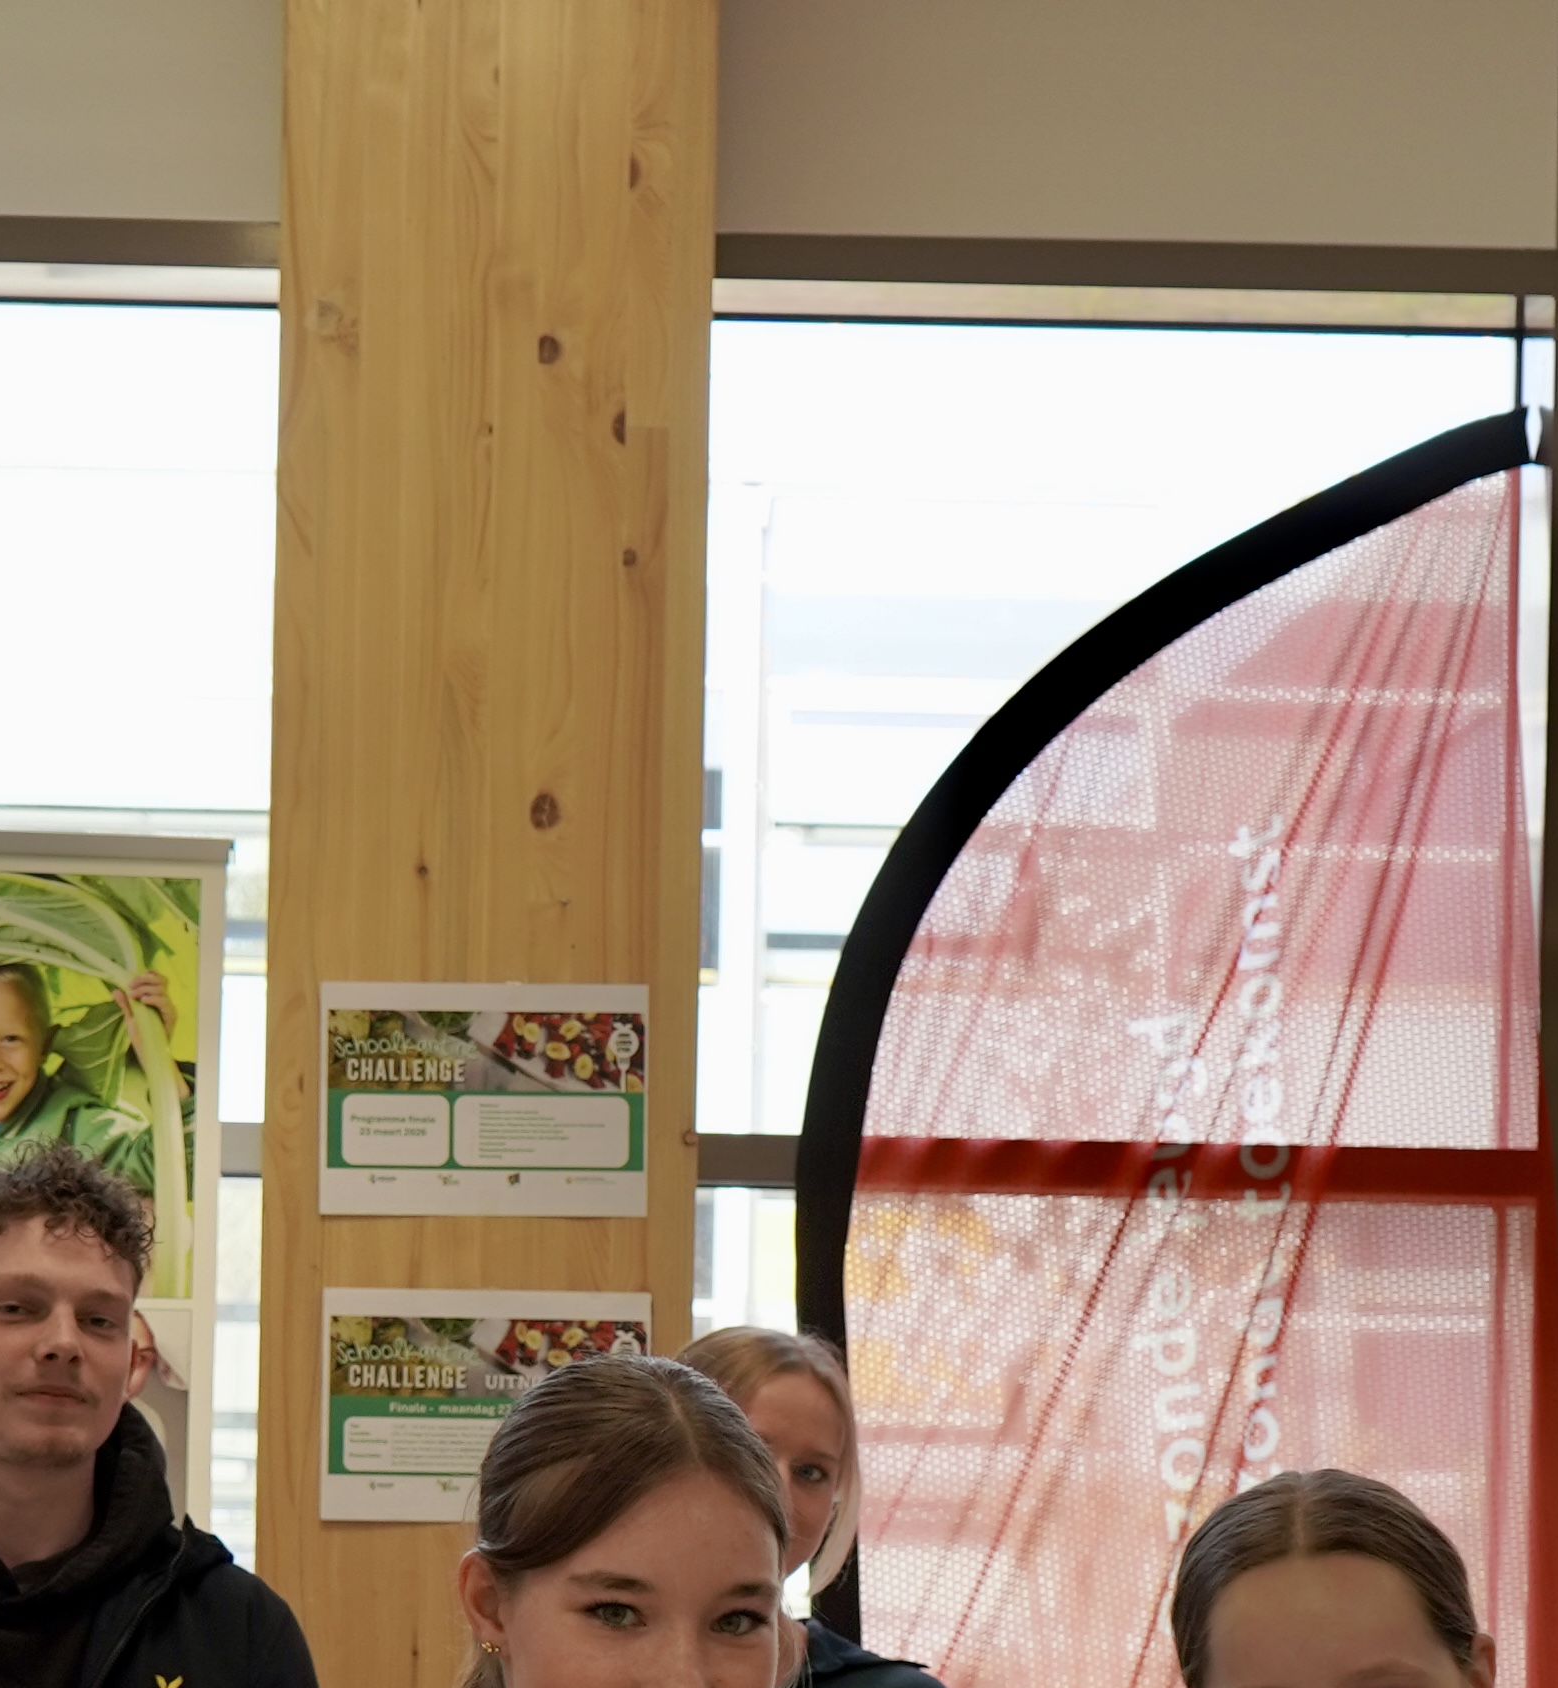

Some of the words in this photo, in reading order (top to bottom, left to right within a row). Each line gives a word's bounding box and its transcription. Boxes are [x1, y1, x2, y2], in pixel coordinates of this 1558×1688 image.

[345, 1058, 466, 1083] CHALLENGE
[348, 1364, 468, 1389] CHALLENGE
[484, 1374, 539, 1391] UITN
[389, 1402, 426, 1414] Finale
[438, 1403, 496, 1416] maandag
